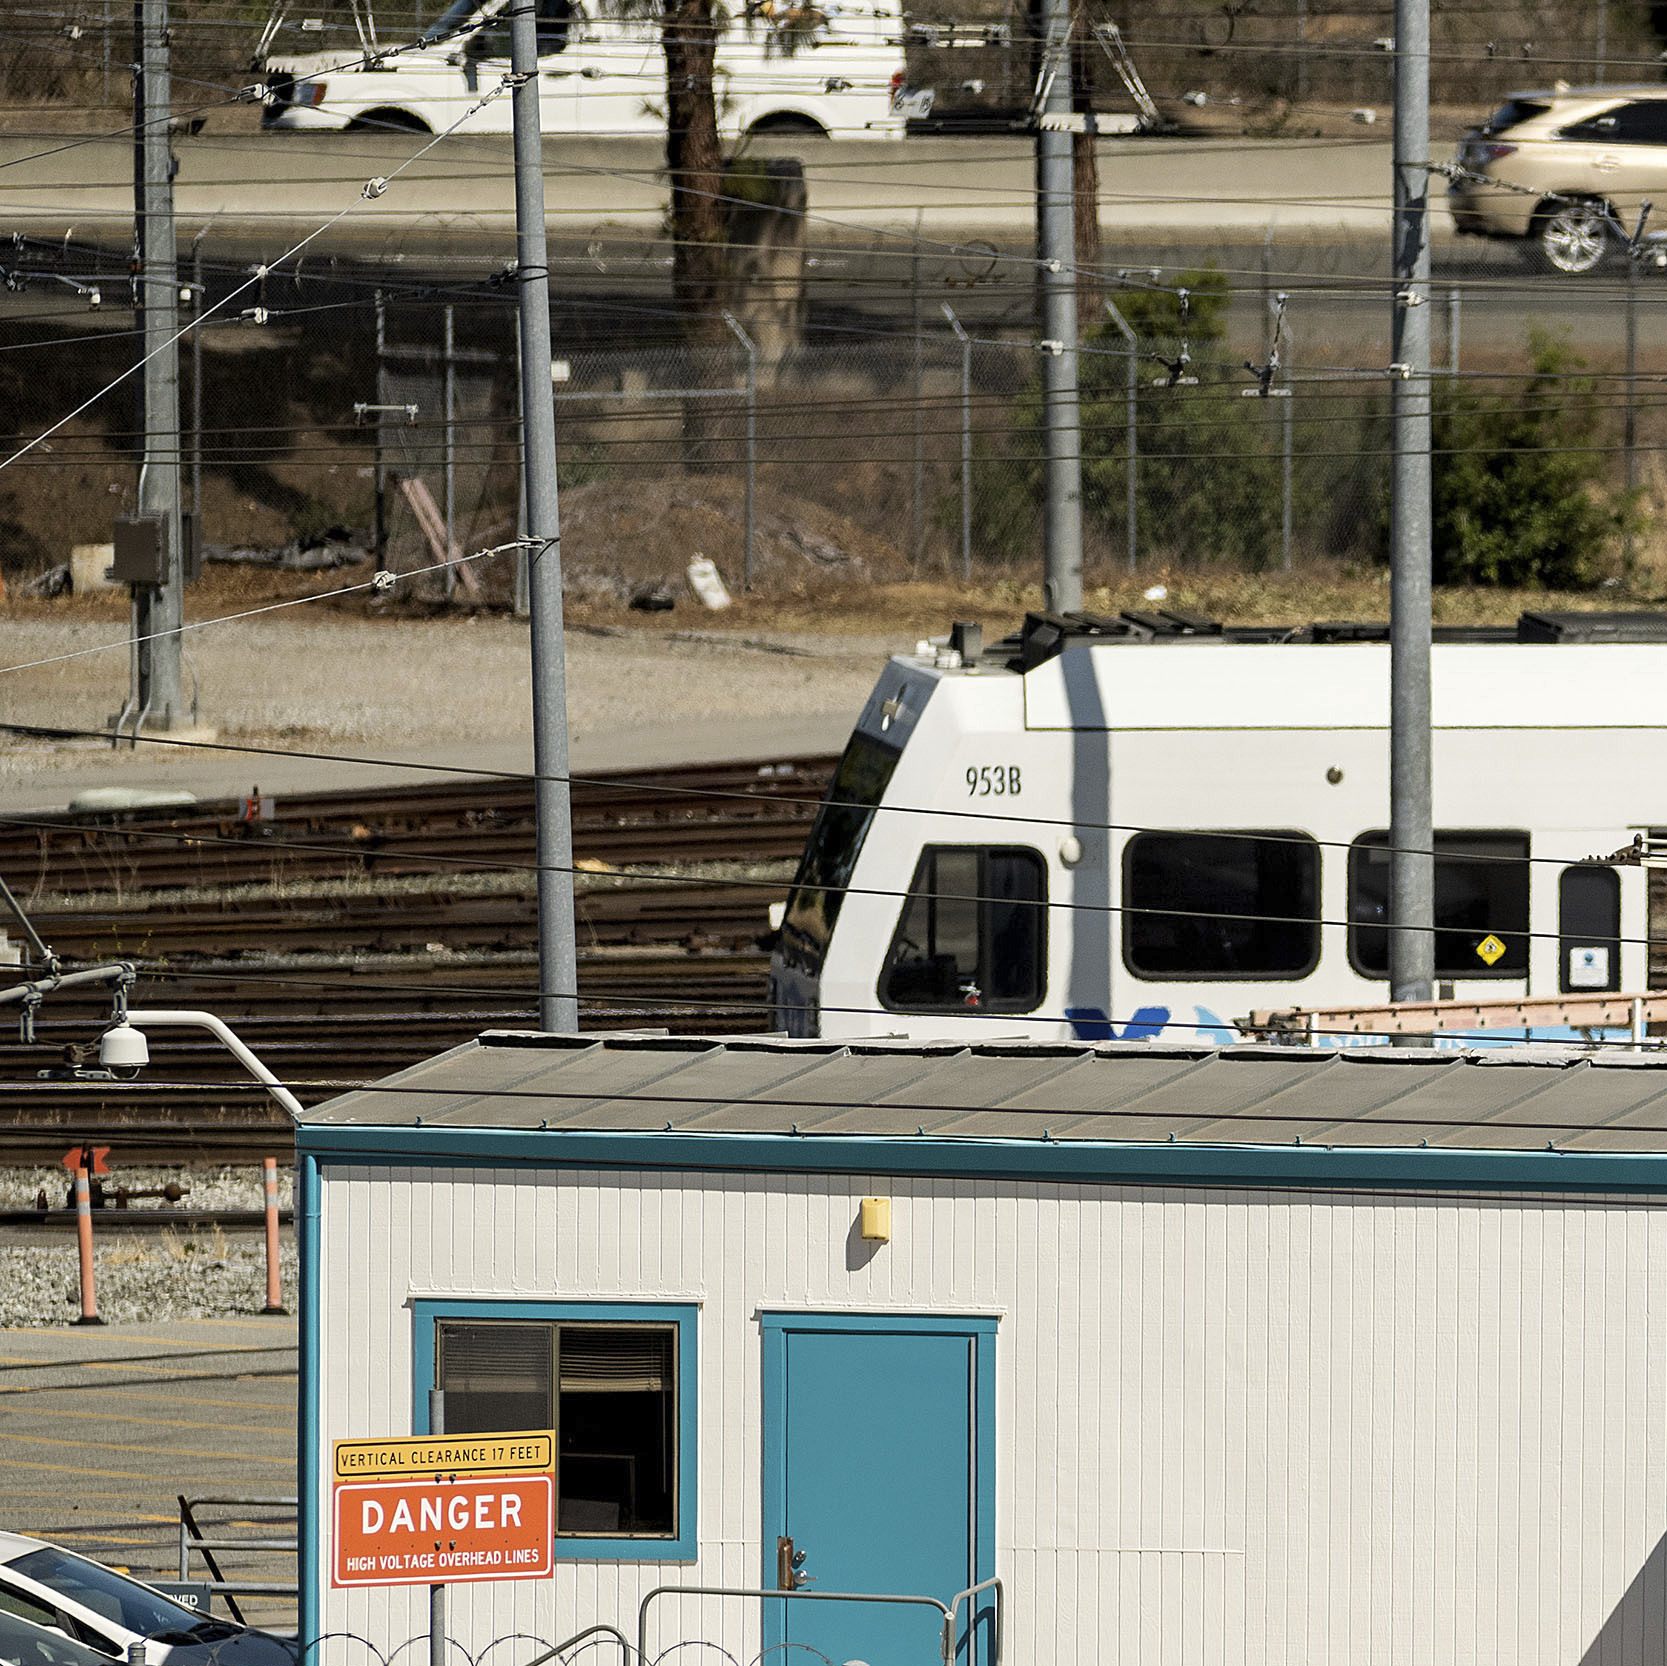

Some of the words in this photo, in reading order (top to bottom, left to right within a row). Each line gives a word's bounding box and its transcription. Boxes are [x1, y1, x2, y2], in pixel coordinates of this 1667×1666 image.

[966, 765, 1022, 797] 953B
[341, 1452, 405, 1467] VERTICAL
[411, 1448, 486, 1464] CLEARANCE
[492, 1447, 505, 1461] 17
[510, 1446, 541, 1460] FEET
[362, 1493, 522, 1534] DANGER
[347, 1556, 376, 1571] HIGH
[380, 1553, 435, 1570] VOLTAGE
[439, 1550, 501, 1567] OVERHEAD
[505, 1548, 539, 1564] LINES
